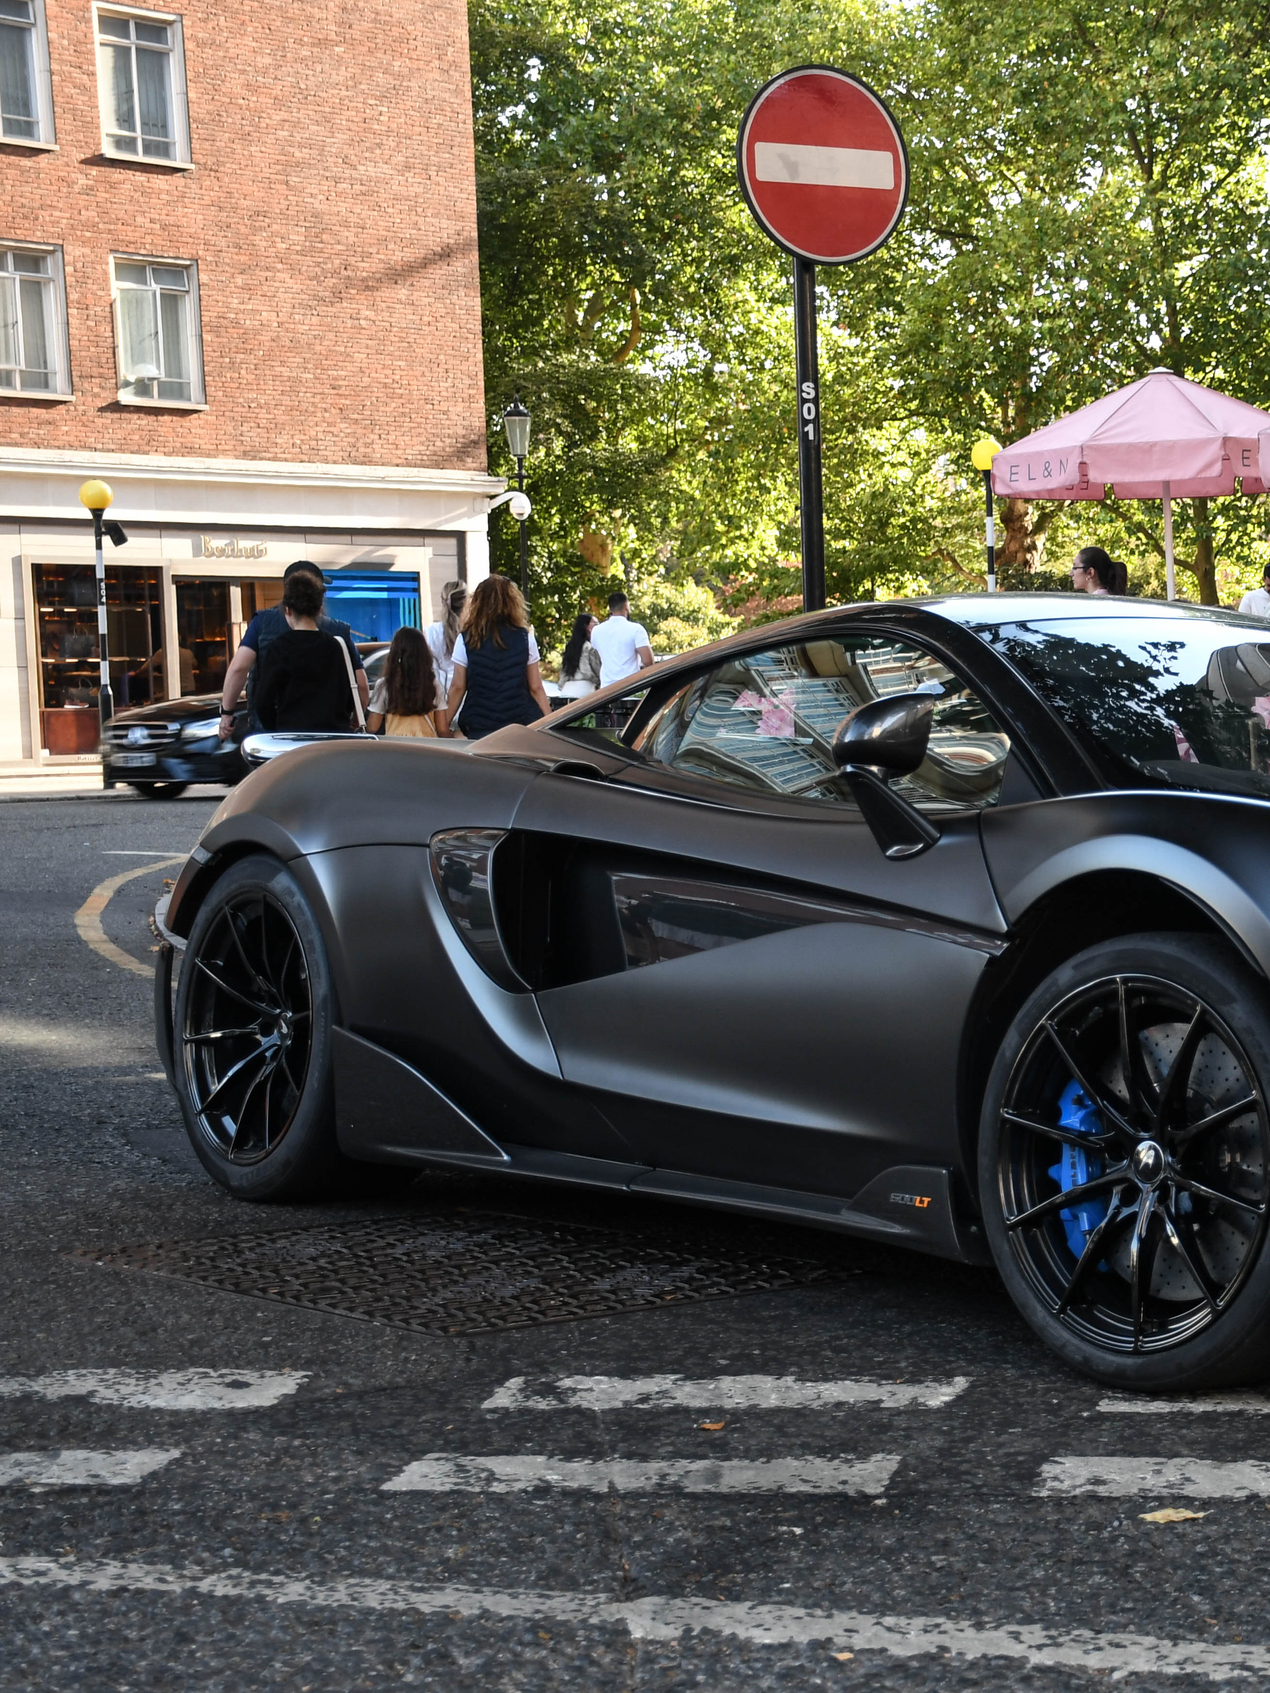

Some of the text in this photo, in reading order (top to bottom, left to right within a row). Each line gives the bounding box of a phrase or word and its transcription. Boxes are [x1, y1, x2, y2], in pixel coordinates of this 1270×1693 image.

[801, 381, 816, 441] S01
[1008, 458, 1069, 482] EL&N
[200, 535, 268, 557] Berluti
